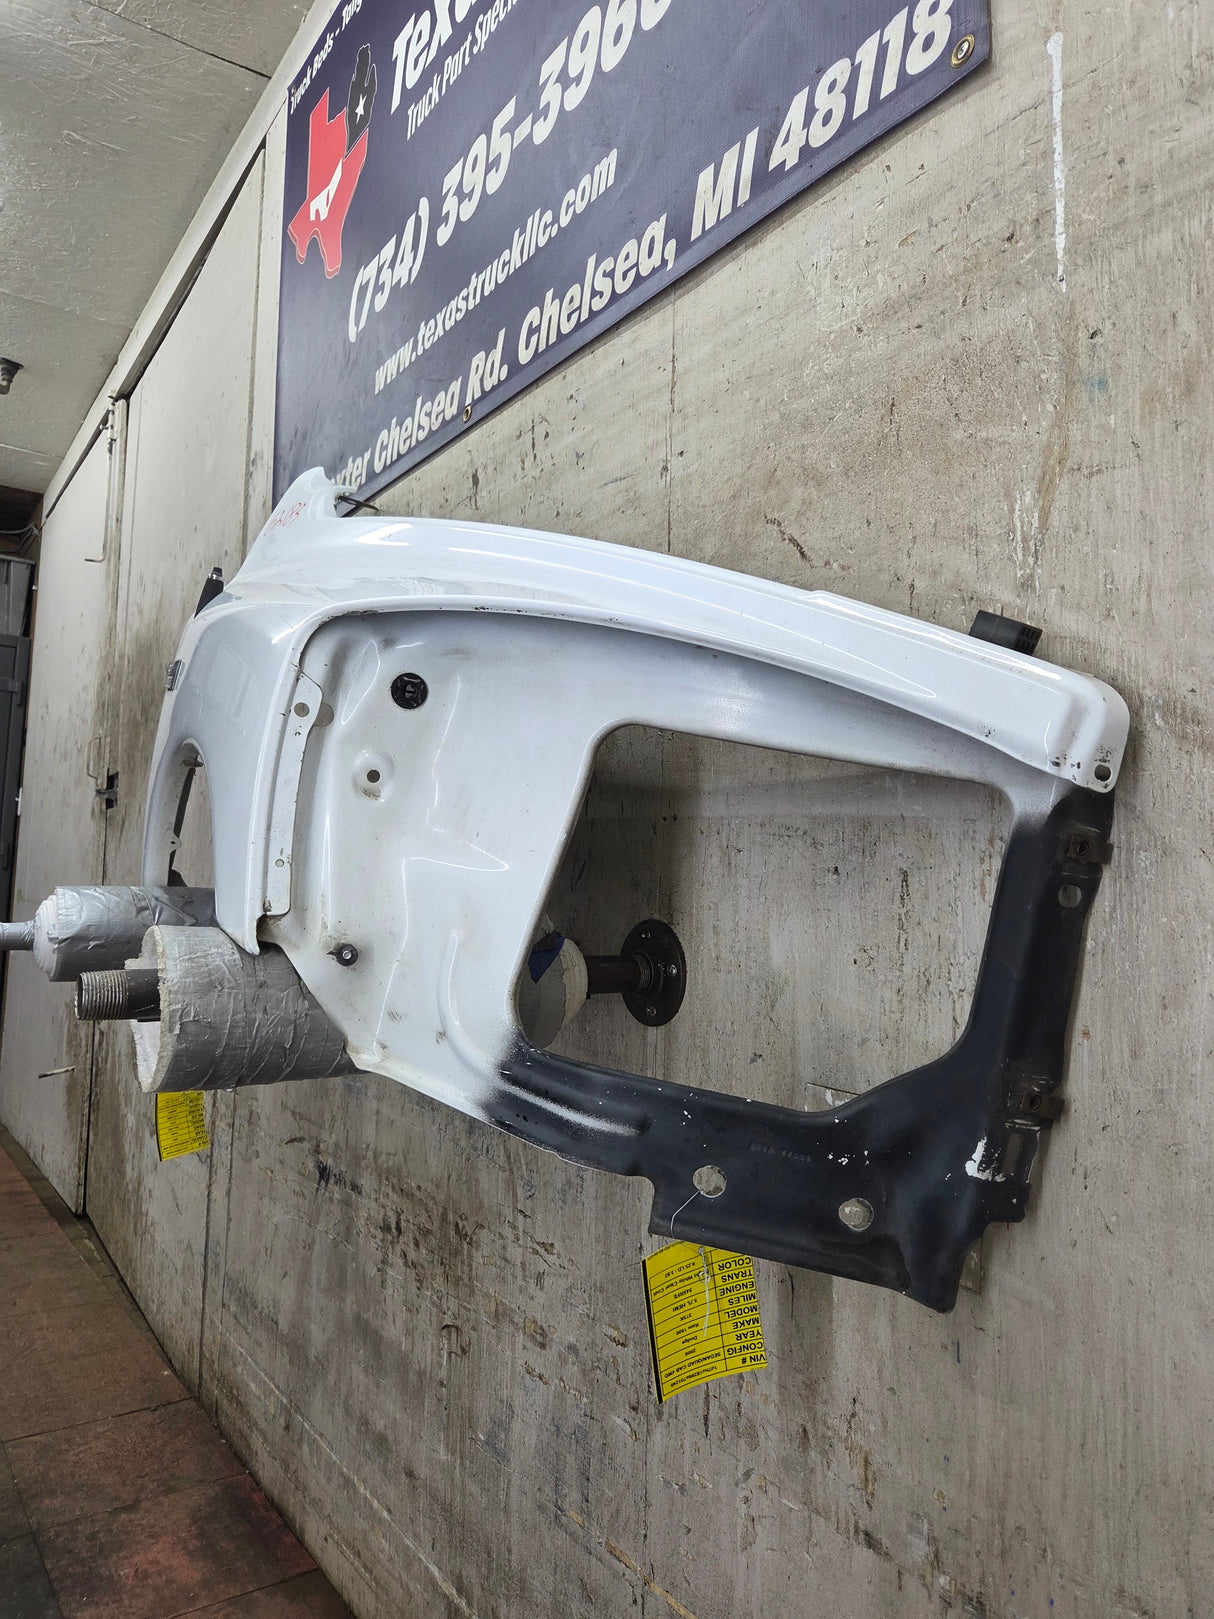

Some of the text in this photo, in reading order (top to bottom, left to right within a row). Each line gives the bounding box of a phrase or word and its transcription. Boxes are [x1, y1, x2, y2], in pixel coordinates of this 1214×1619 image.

[391, 0, 478, 115] Tex
[407, 0, 518, 141] Truck Part Spec
[374, 376, 462, 474] Chelsea
[465, 327, 509, 406] Rd.
[518, 213, 677, 365] Chelsea,
[690, 126, 760, 242] MI
[768, 0, 952, 172] 48118
[349, 197, 429, 343] (734)
[374, 148, 617, 395] www.texastruckllc.com
[718, 1257, 752, 1271] COLOR
[721, 1269, 753, 1283] TRANS
[719, 1281, 755, 1296] ENGINE
[728, 1292, 756, 1306] MILES
[724, 1305, 758, 1319] MODEL
[732, 1316, 760, 1330] MAKE
[735, 1329, 762, 1341] YEAR
[726, 1341, 764, 1356] CONFIG
[741, 1354, 766, 1365] VIN #
